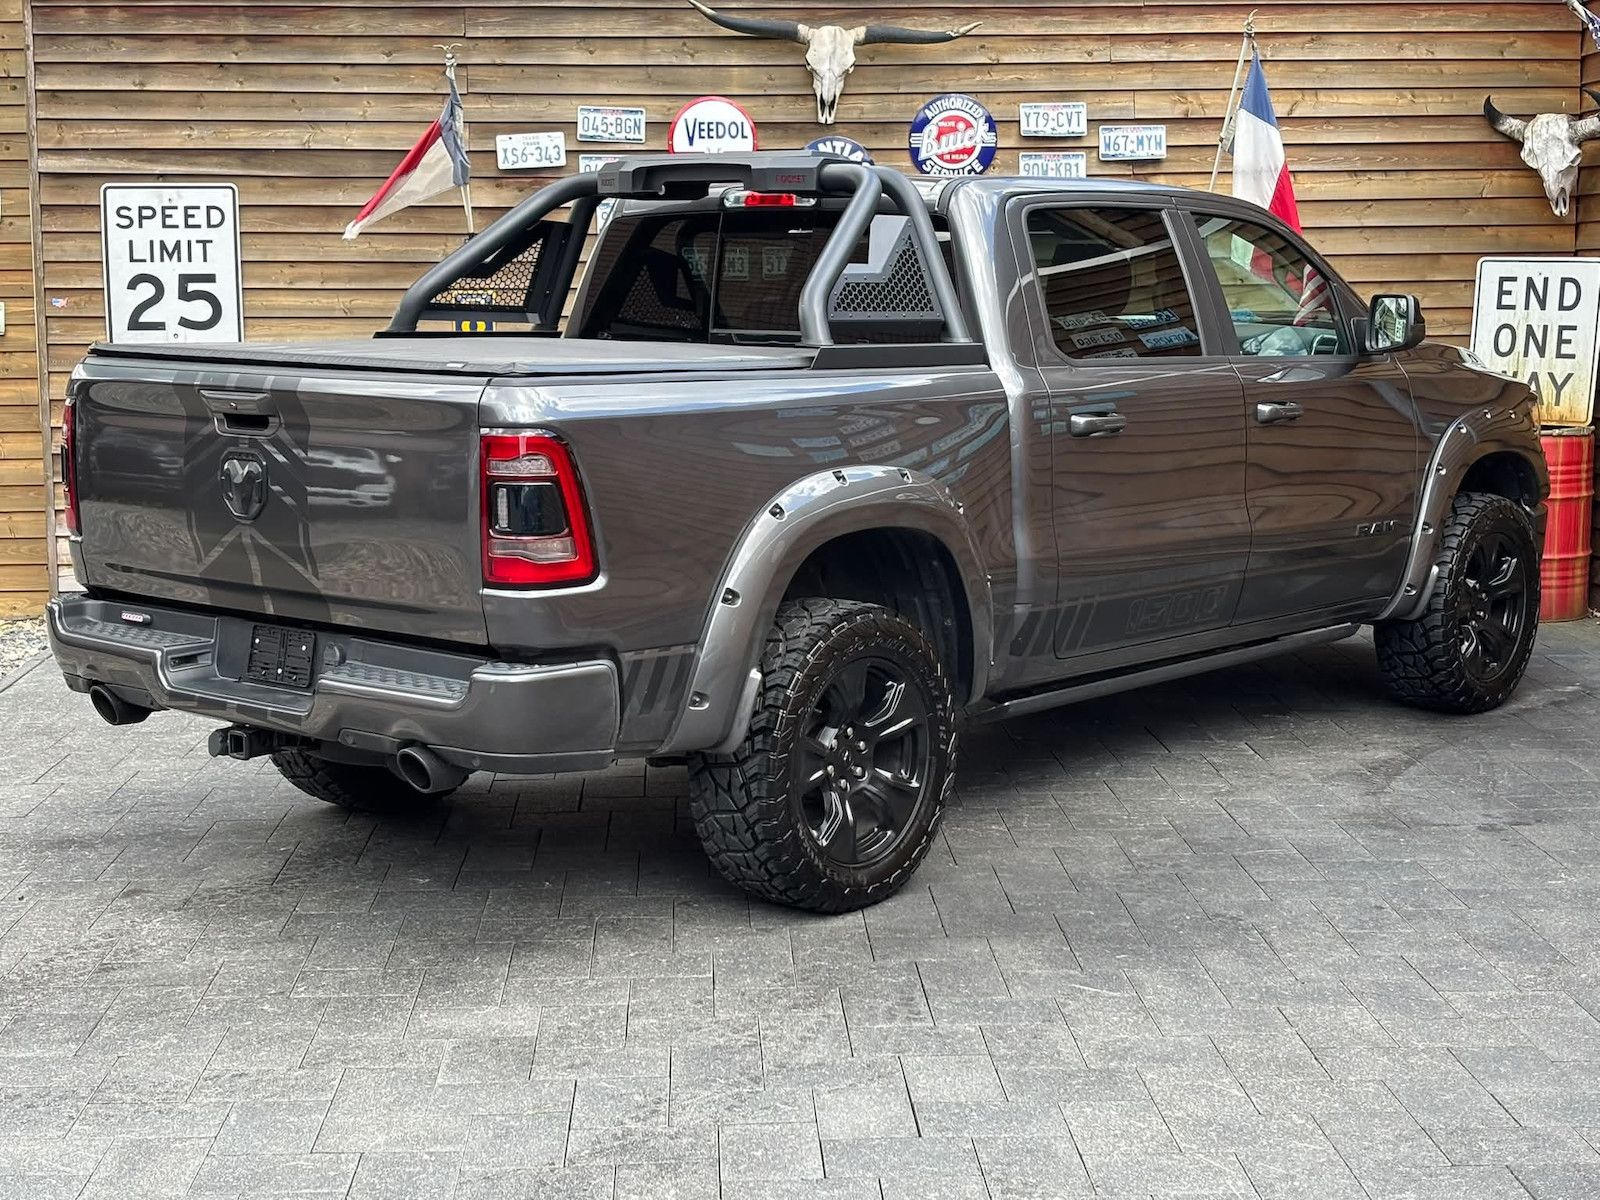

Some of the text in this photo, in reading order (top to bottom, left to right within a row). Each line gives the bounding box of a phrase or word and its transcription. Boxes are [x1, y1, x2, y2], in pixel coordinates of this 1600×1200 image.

[924, 97, 983, 119] AUTHORIZED
[684, 117, 748, 147] VEEDOL
[918, 116, 990, 161] Buick
[115, 205, 225, 229] SPEED
[128, 239, 213, 263] LIMIT
[126, 273, 223, 331] 25
[1496, 276, 1582, 311] END
[1493, 323, 1578, 359] ONE
[1501, 371, 1575, 407] AY
